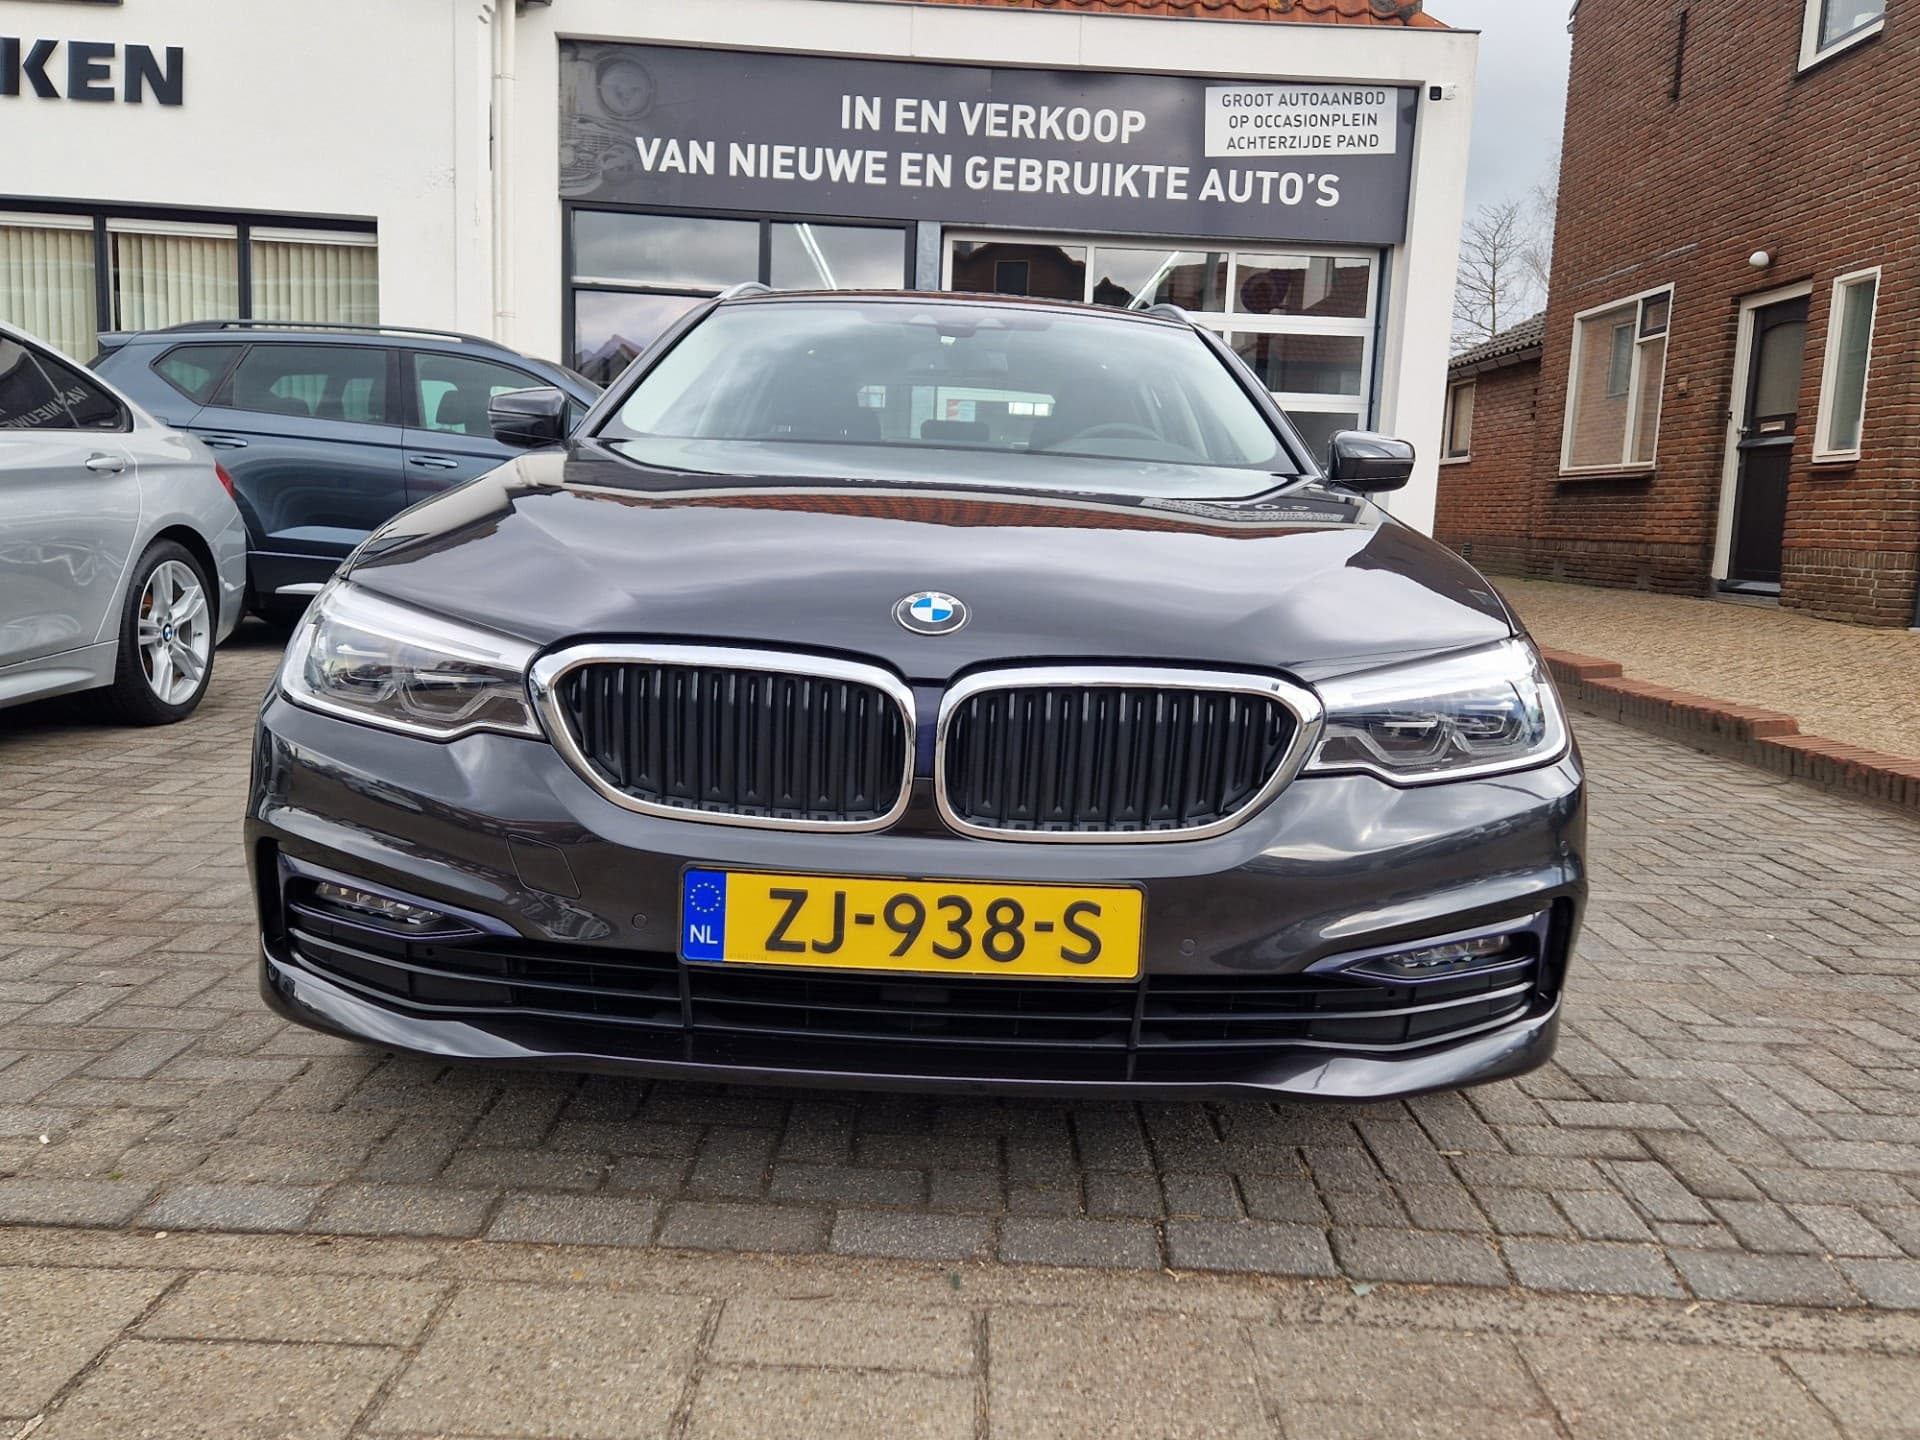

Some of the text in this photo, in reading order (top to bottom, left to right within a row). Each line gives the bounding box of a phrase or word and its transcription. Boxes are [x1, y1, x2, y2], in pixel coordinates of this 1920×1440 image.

[0, 37, 184, 106] KEN
[1222, 91, 1386, 107] GROOT AUTOAANBOD
[841, 95, 1147, 144] IN EN VERKOOP
[1229, 113, 1378, 128] OP OCCASIONPLEIN
[1226, 134, 1379, 150] ACHTERZIJDE PAND
[635, 136, 1340, 207] VAN NIEUWE EN GEBRUIKTE AUTO'S
[690, 924, 718, 945] NL
[765, 887, 1103, 966] ZJ-938-S
